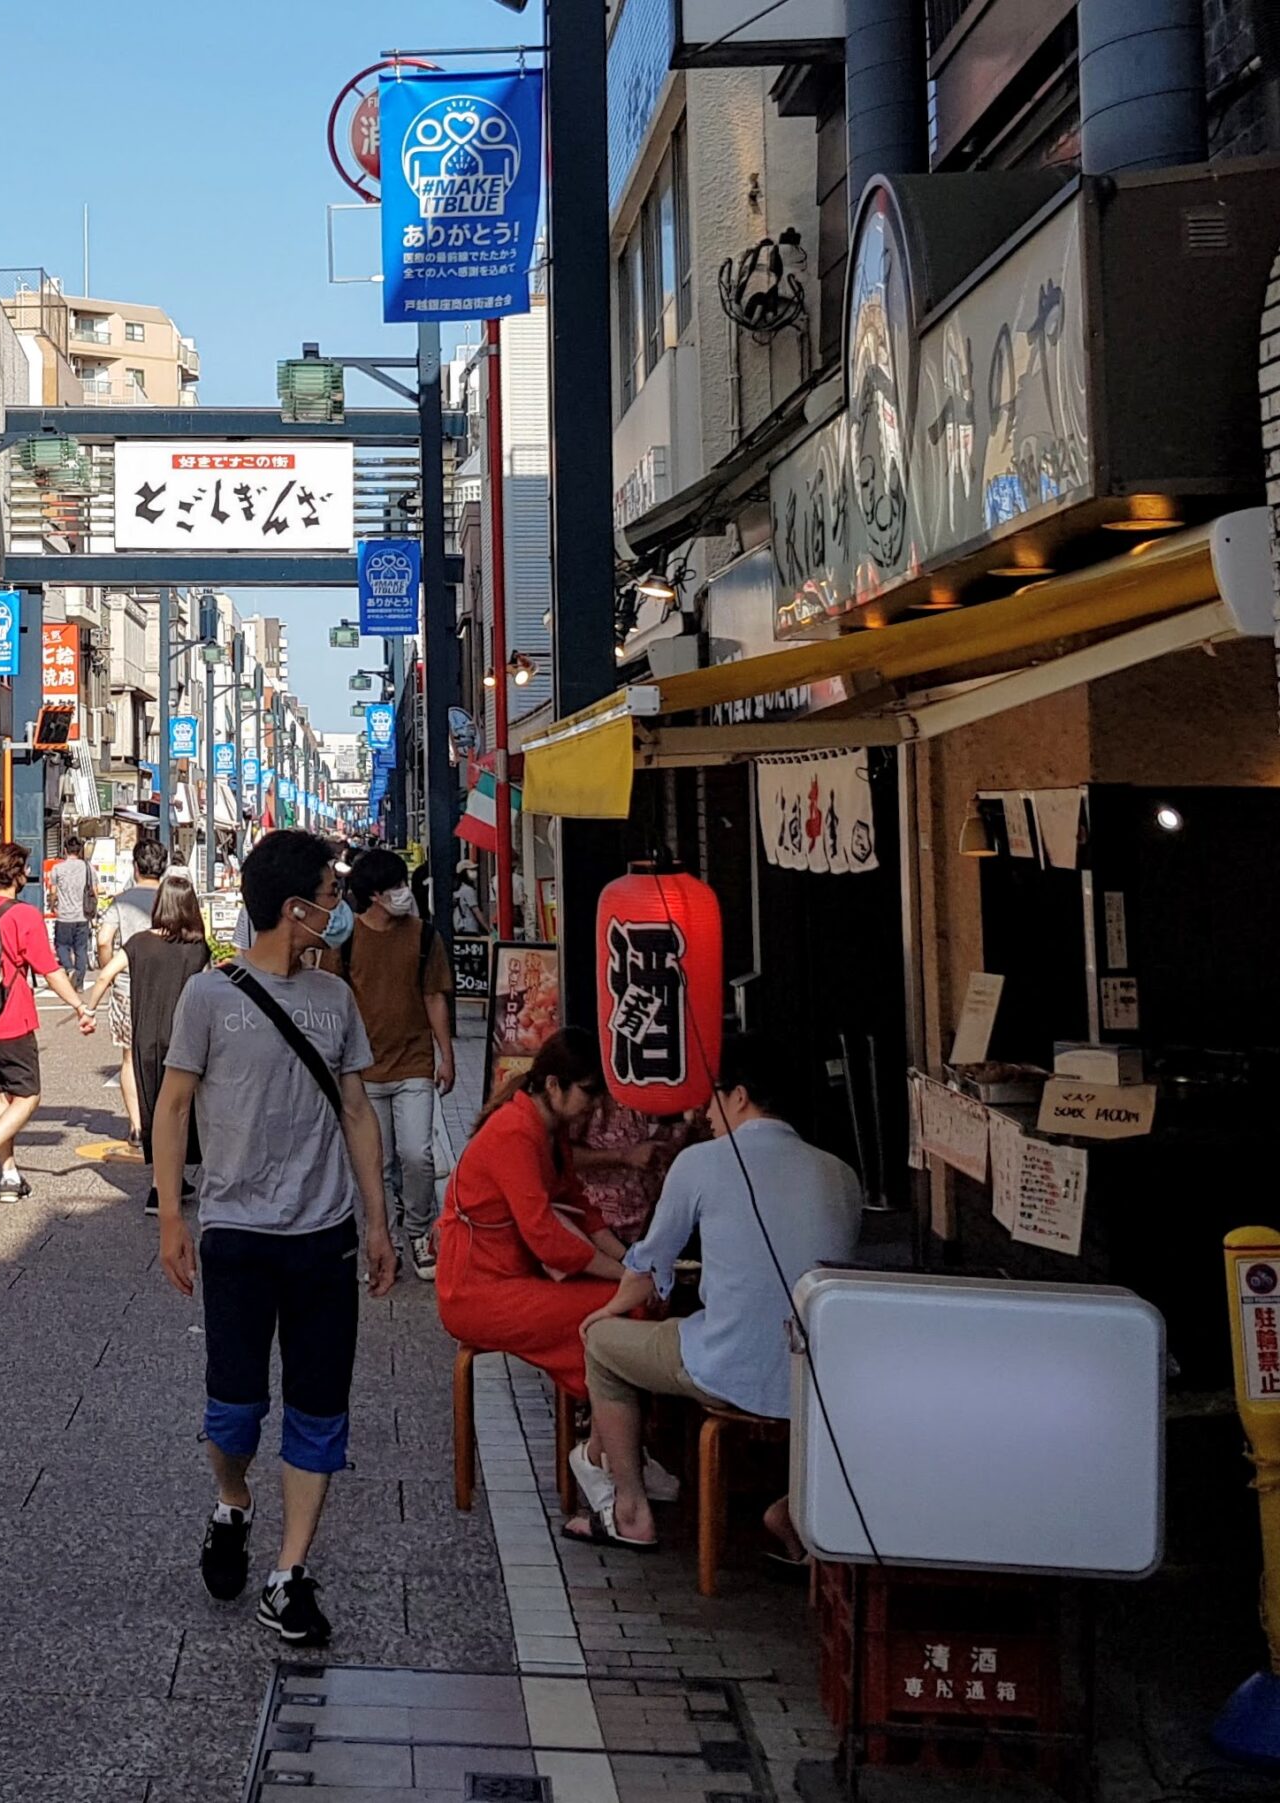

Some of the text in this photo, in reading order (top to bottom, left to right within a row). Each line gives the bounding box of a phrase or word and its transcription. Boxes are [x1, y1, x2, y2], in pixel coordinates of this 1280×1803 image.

[422, 177, 502, 197] #MAKE
[424, 196, 500, 214] ITBLUE
[403, 222, 520, 248] ありがとう!
[178, 455, 290, 468] 好きですこの街
[134, 478, 334, 536] とごしぎんざ
[224, 999, 256, 1032] ck
[1062, 1093, 1097, 1103] マスク
[1254, 1307, 1280, 1394] 駐輪禁止
